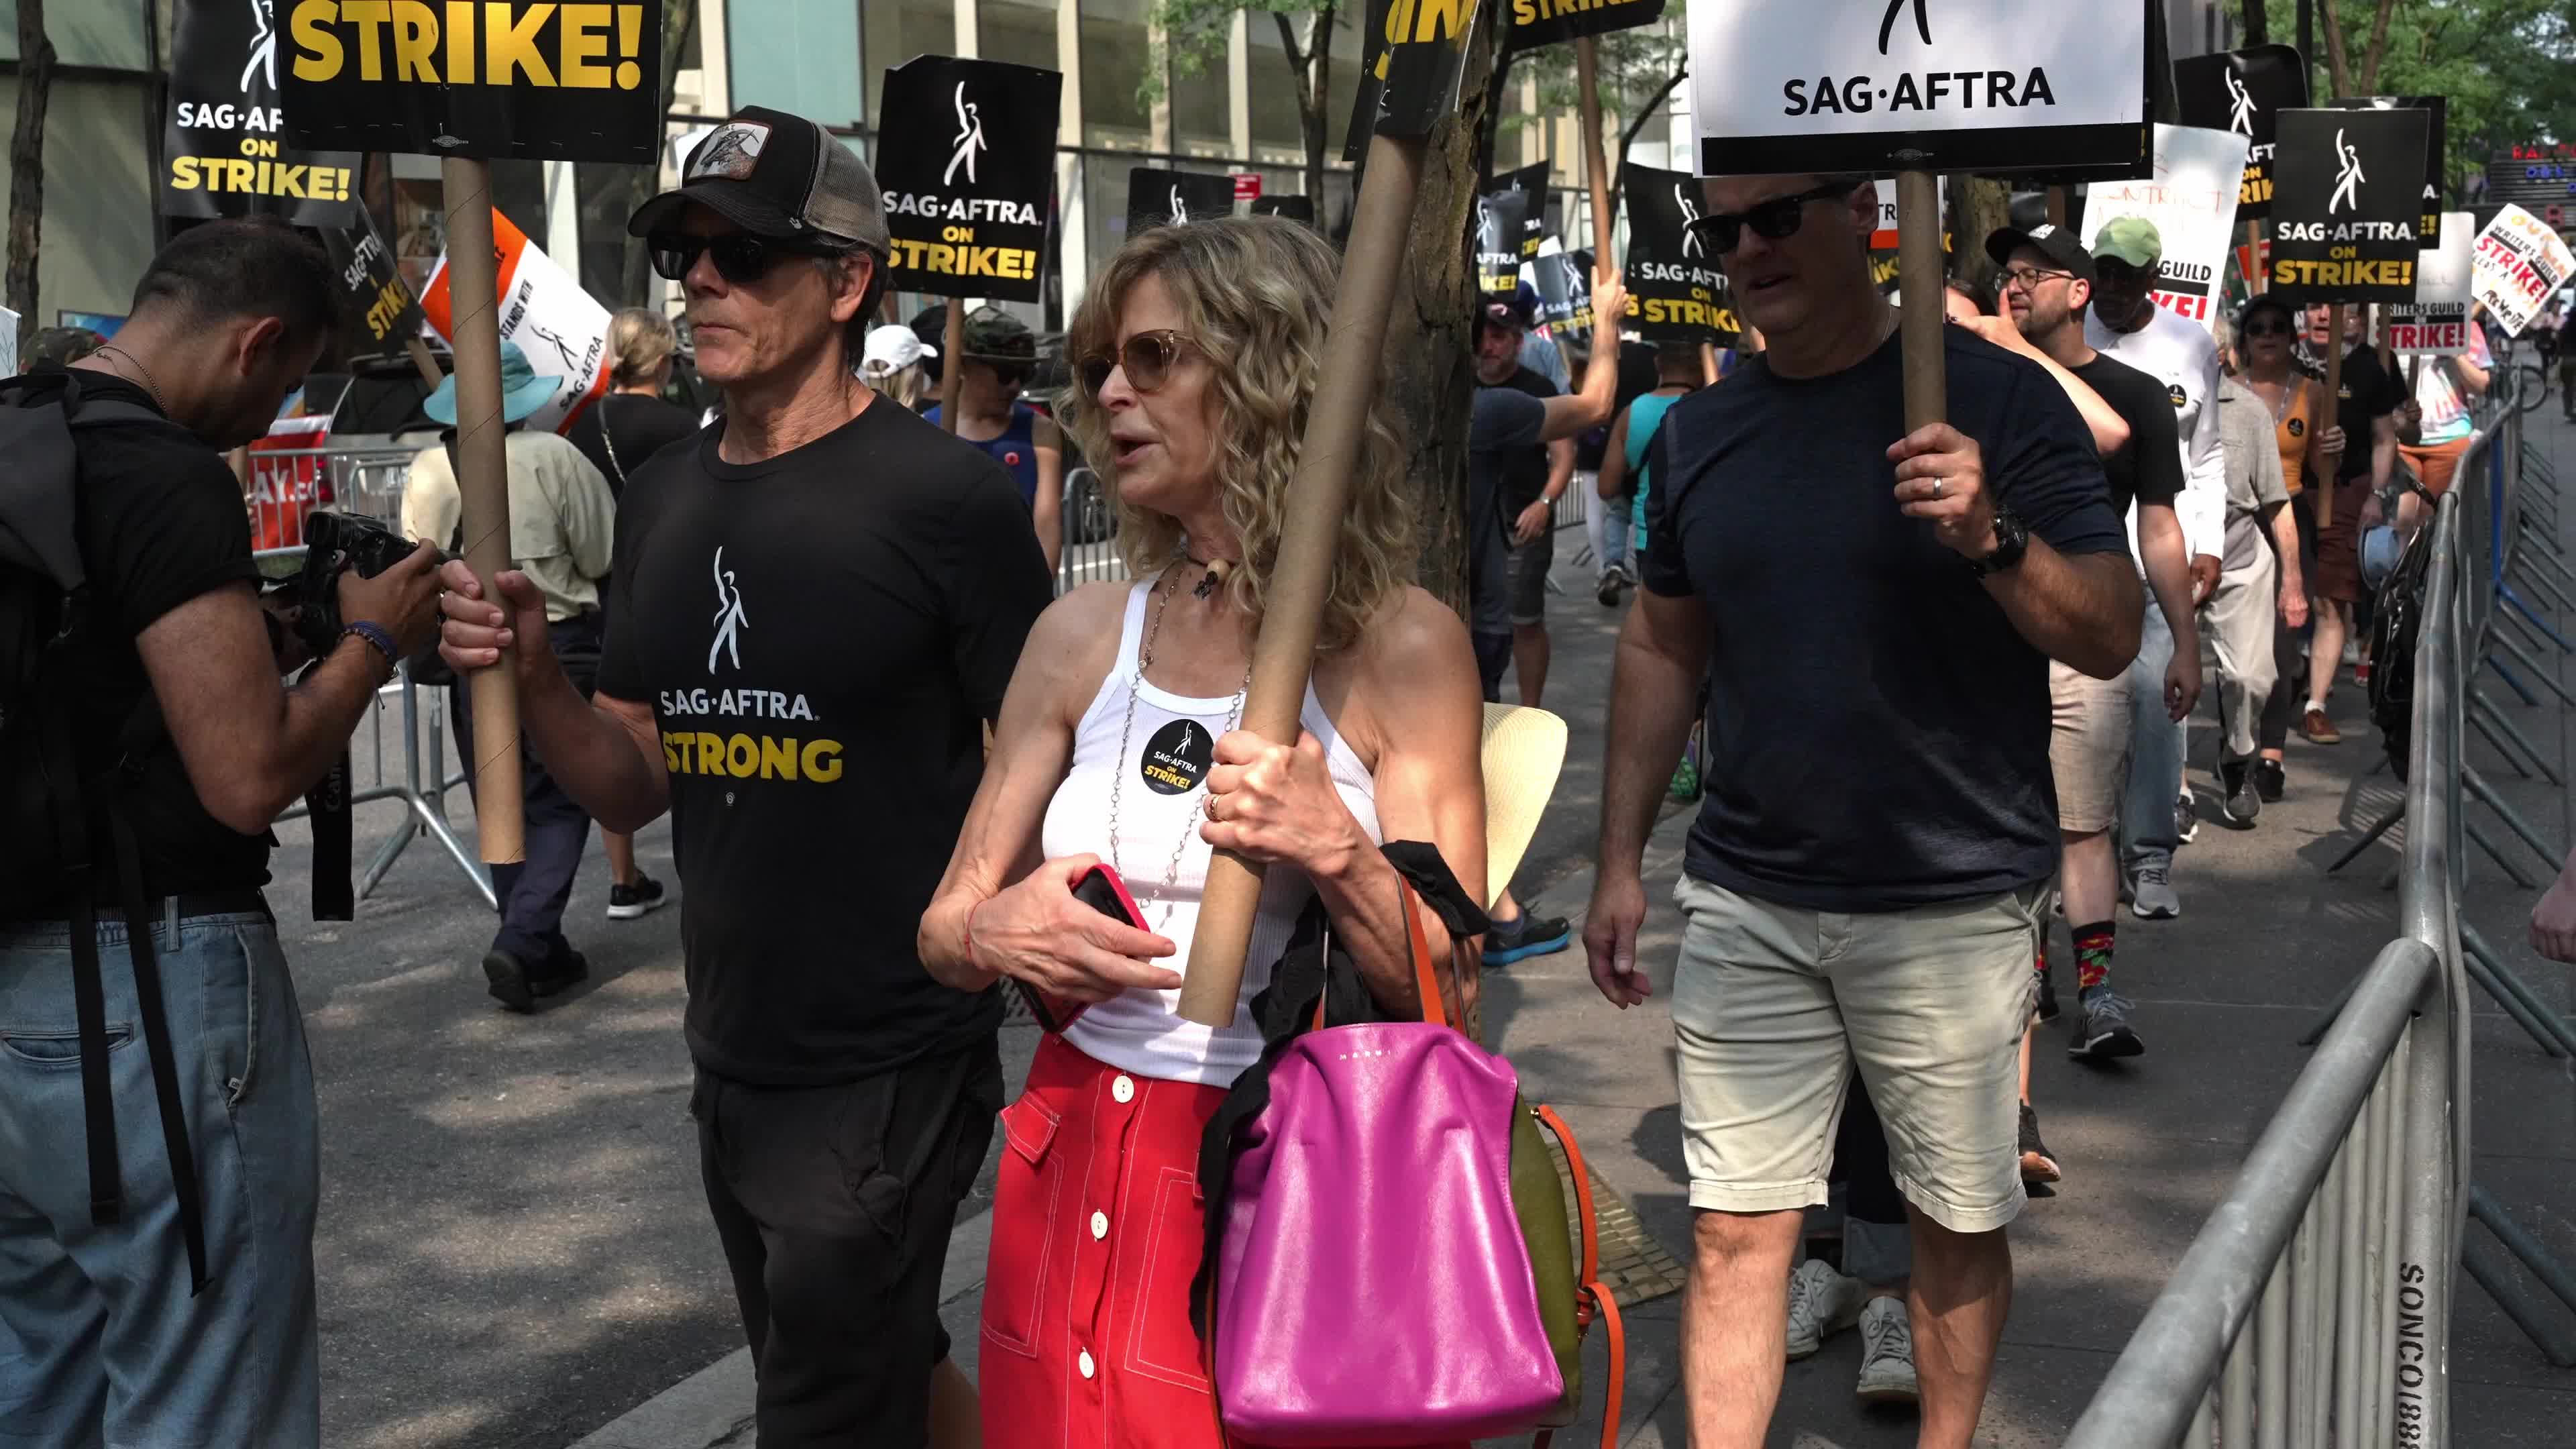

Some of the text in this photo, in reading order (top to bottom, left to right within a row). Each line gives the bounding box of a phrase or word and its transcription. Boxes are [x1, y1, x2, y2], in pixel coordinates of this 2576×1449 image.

[290, 0, 643, 90] STRIKE!
[240, 138, 277, 158] ON
[171, 156, 352, 201] STRIKE!
[943, 225, 974, 243] ON
[2495, 223, 2536, 256] WRITERS
[2330, 246, 2357, 259] ON
[2160, 261, 2212, 281] GUILD
[2275, 260, 2412, 286] STRIKE!
[2477, 237, 2550, 304] STRIKE!
[500, 278, 533, 340] STANDS WITH
[2430, 302, 2465, 314] GUILD
[2378, 323, 2465, 349] TRIKE!
[663, 730, 843, 783] STRONG
[1144, 765, 1191, 789] STRIKE!
